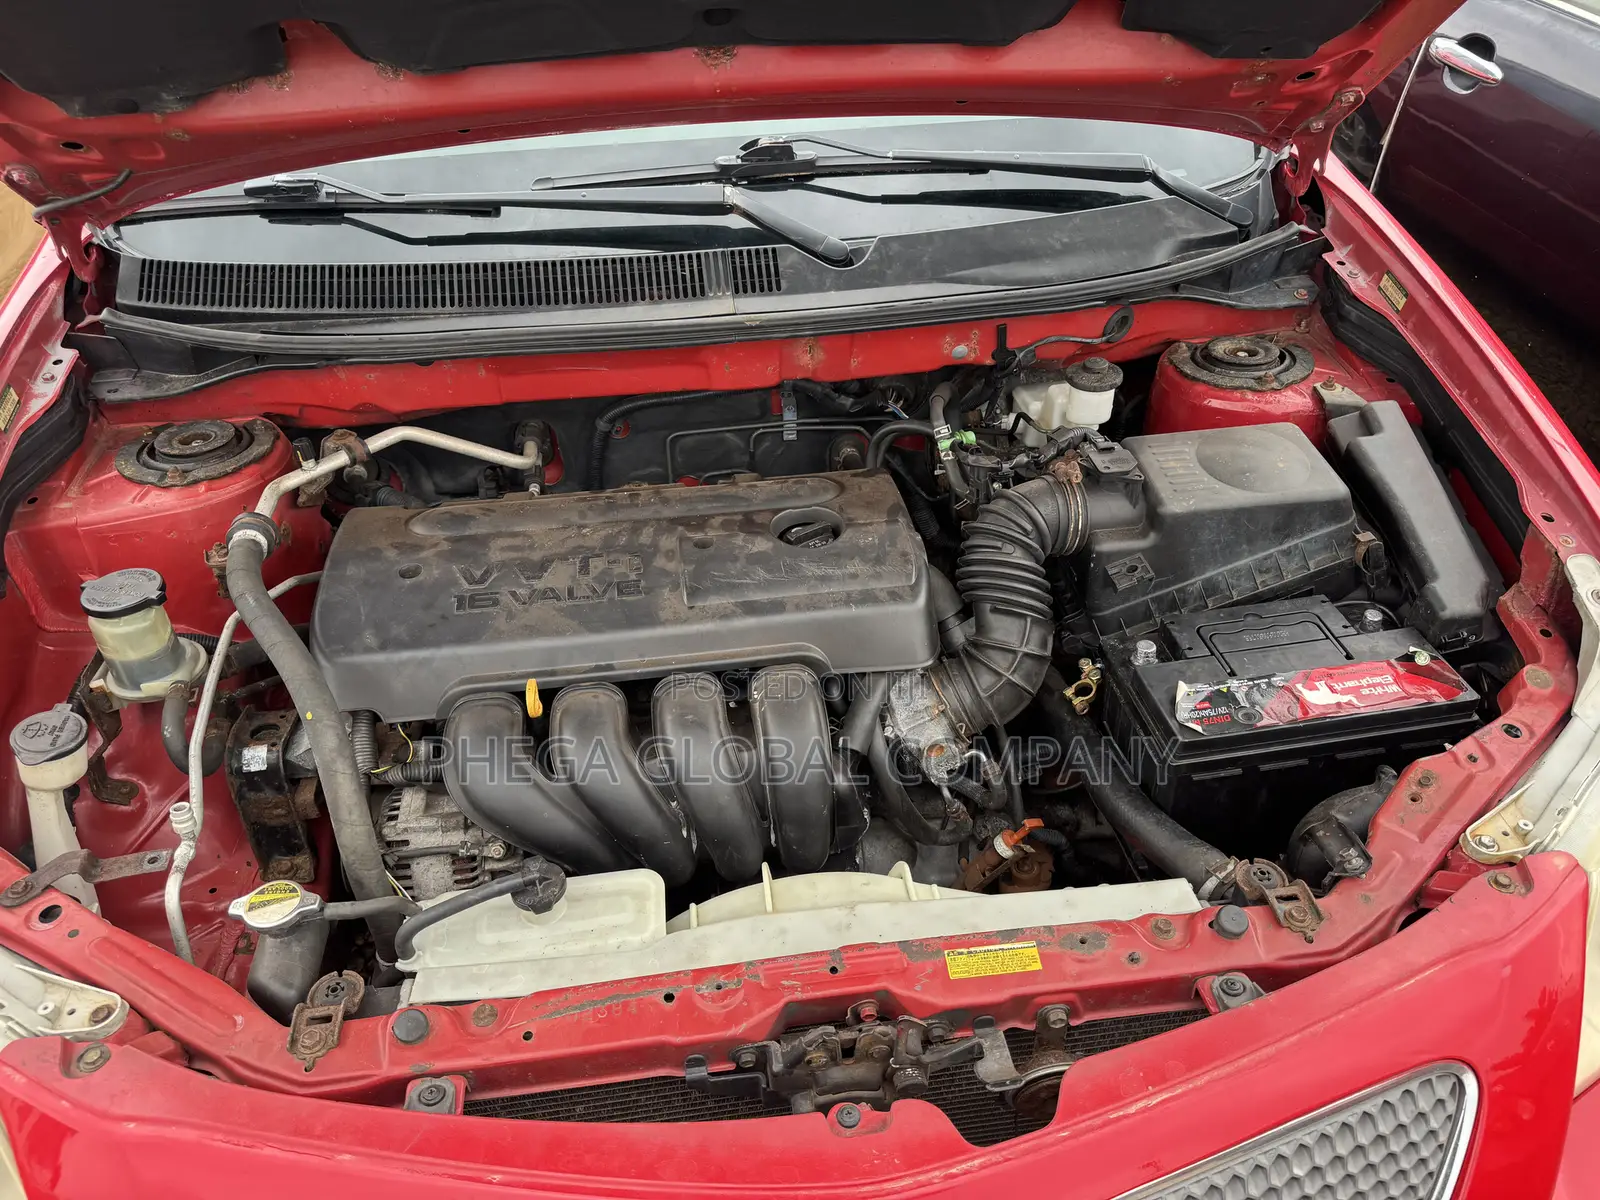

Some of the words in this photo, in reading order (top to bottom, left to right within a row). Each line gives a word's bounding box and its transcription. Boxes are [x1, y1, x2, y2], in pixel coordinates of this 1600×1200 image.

[452, 591, 500, 614] 16
[507, 579, 644, 609] VALVE
[1330, 674, 1395, 690] Elephant
[1360, 683, 1402, 695] White
[1203, 714, 1231, 726] DIN75
